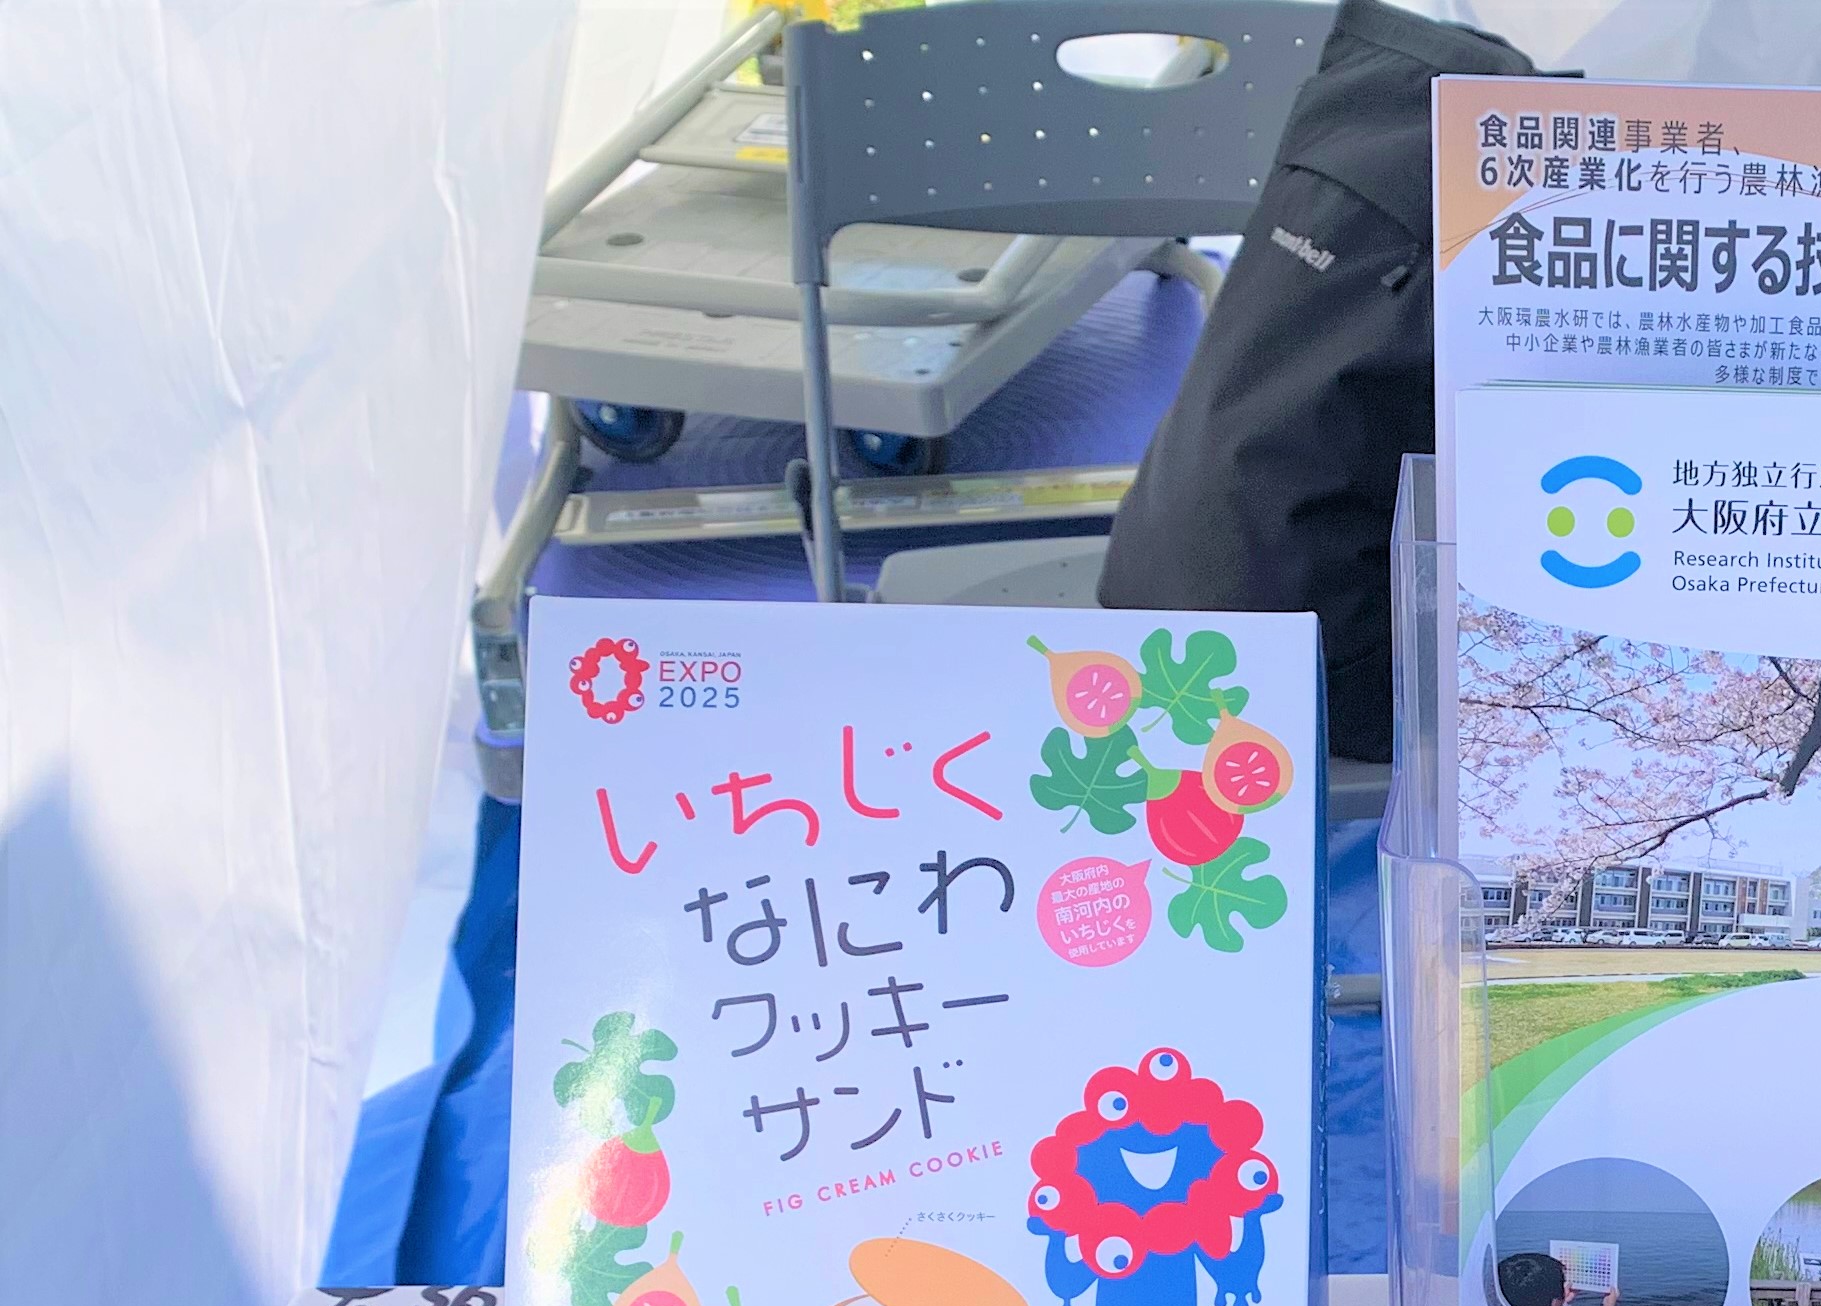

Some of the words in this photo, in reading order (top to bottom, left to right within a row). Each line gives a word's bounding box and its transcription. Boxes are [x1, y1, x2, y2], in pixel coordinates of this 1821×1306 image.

[1479, 114, 1742, 156] 食品関連事業者、
[1673, 550, 1761, 570] Research
[1672, 575, 1732, 593] Osaka
[659, 660, 742, 683] EXPO
[658, 686, 741, 709] 2025
[597, 725, 1004, 876] いちじく
[1060, 864, 1110, 887] 大阪府内
[684, 850, 1016, 967] なにわ
[1054, 893, 1131, 925] 南河内の
[1061, 915, 1137, 945] いちじくを
[711, 976, 1010, 1063] クッキー
[743, 1057, 965, 1162] サンド
[762, 1193, 804, 1217] FIG
[817, 1168, 897, 1202] CREAM
[908, 1140, 1004, 1178] COOKIE
[916, 1211, 996, 1223] さくさくクッキー
